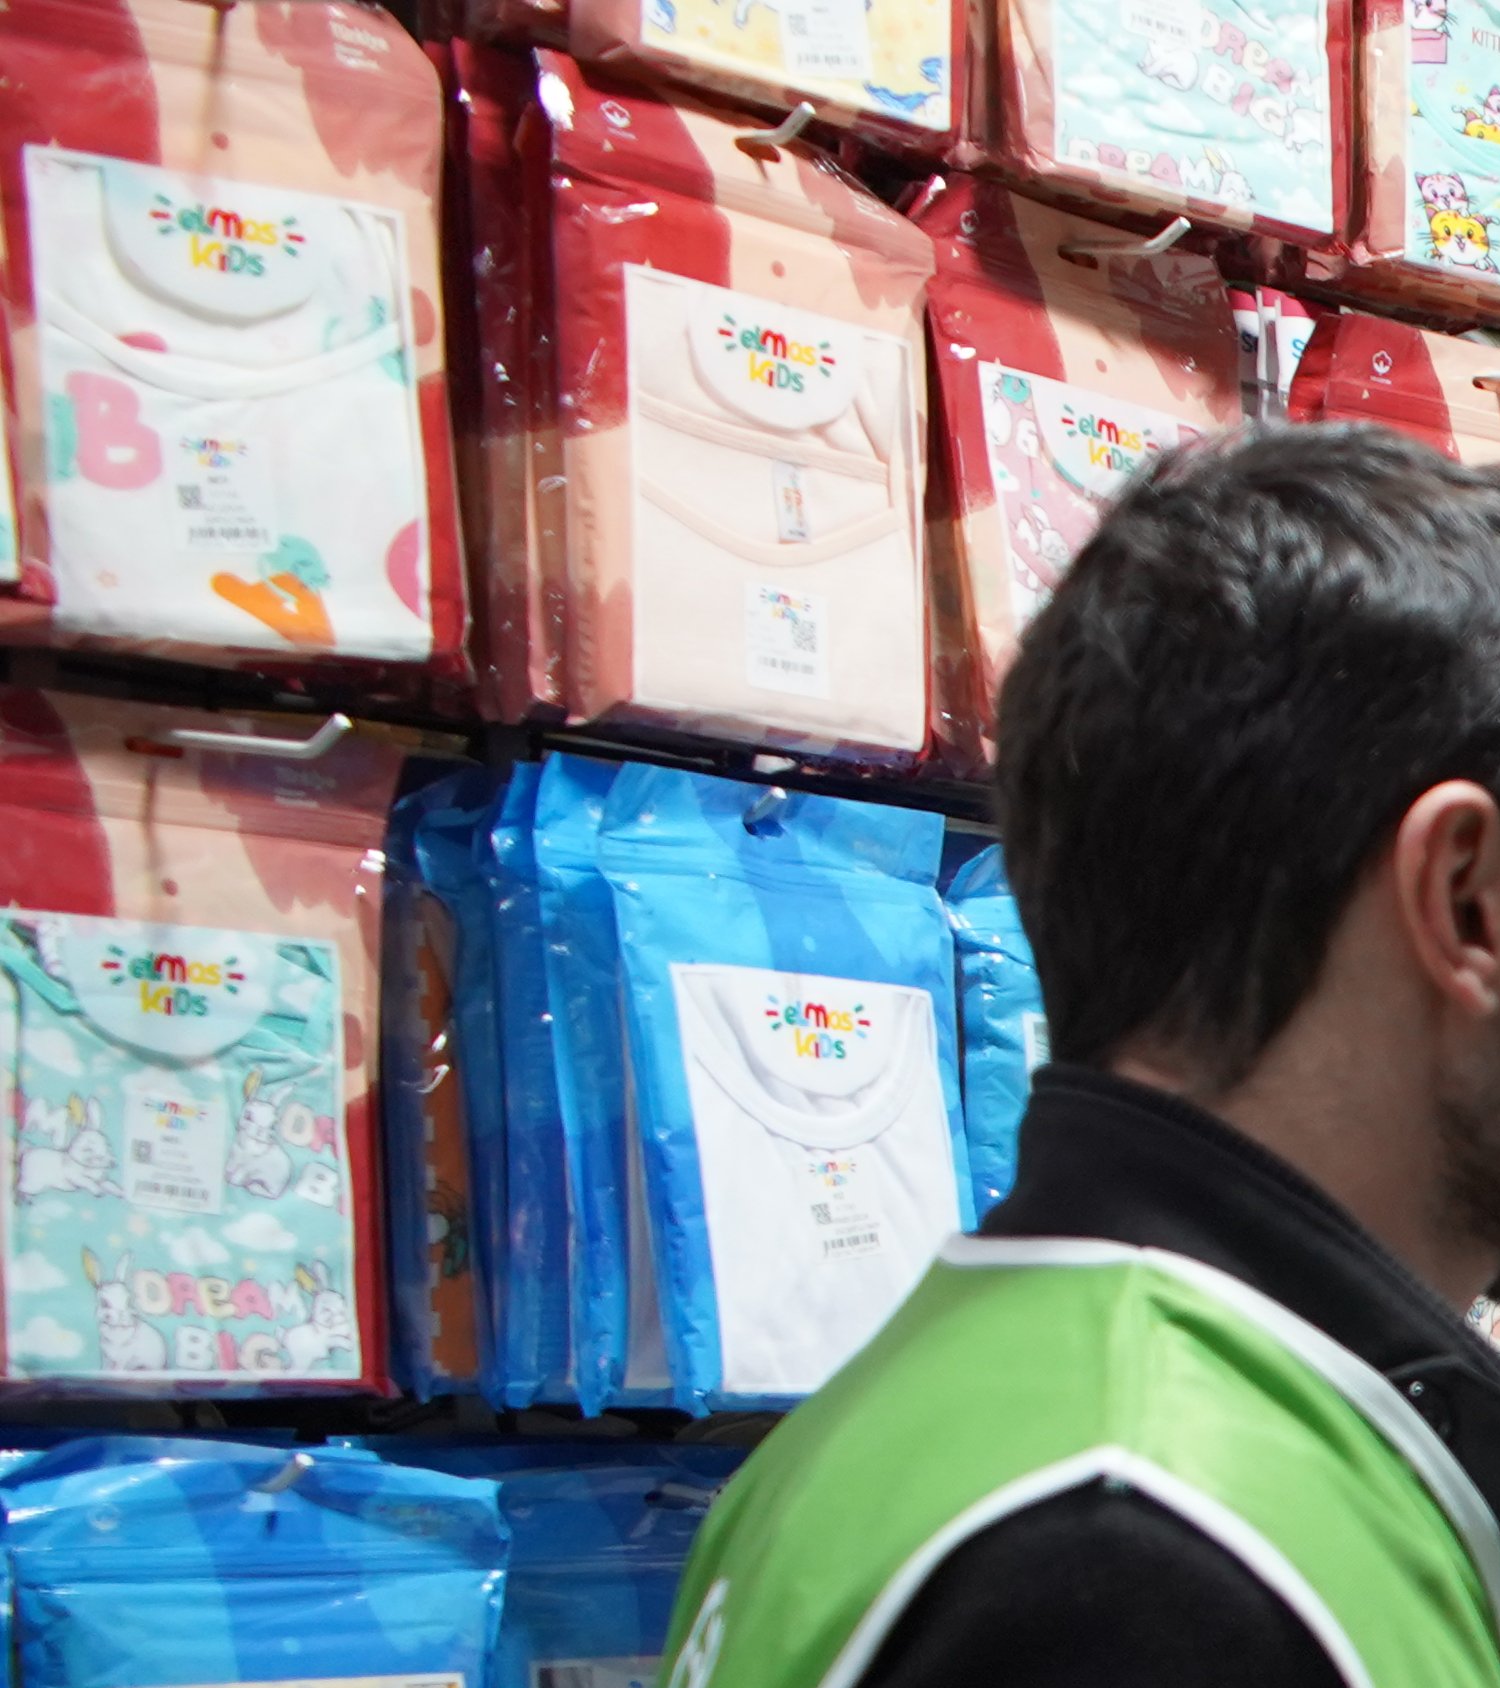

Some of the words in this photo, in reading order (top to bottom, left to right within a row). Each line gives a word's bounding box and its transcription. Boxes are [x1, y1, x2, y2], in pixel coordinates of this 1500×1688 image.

[740, 325, 816, 367] elmas
[1078, 414, 1143, 452] elmas
[128, 950, 221, 982] elmas
[784, 1000, 854, 1031] elmas
